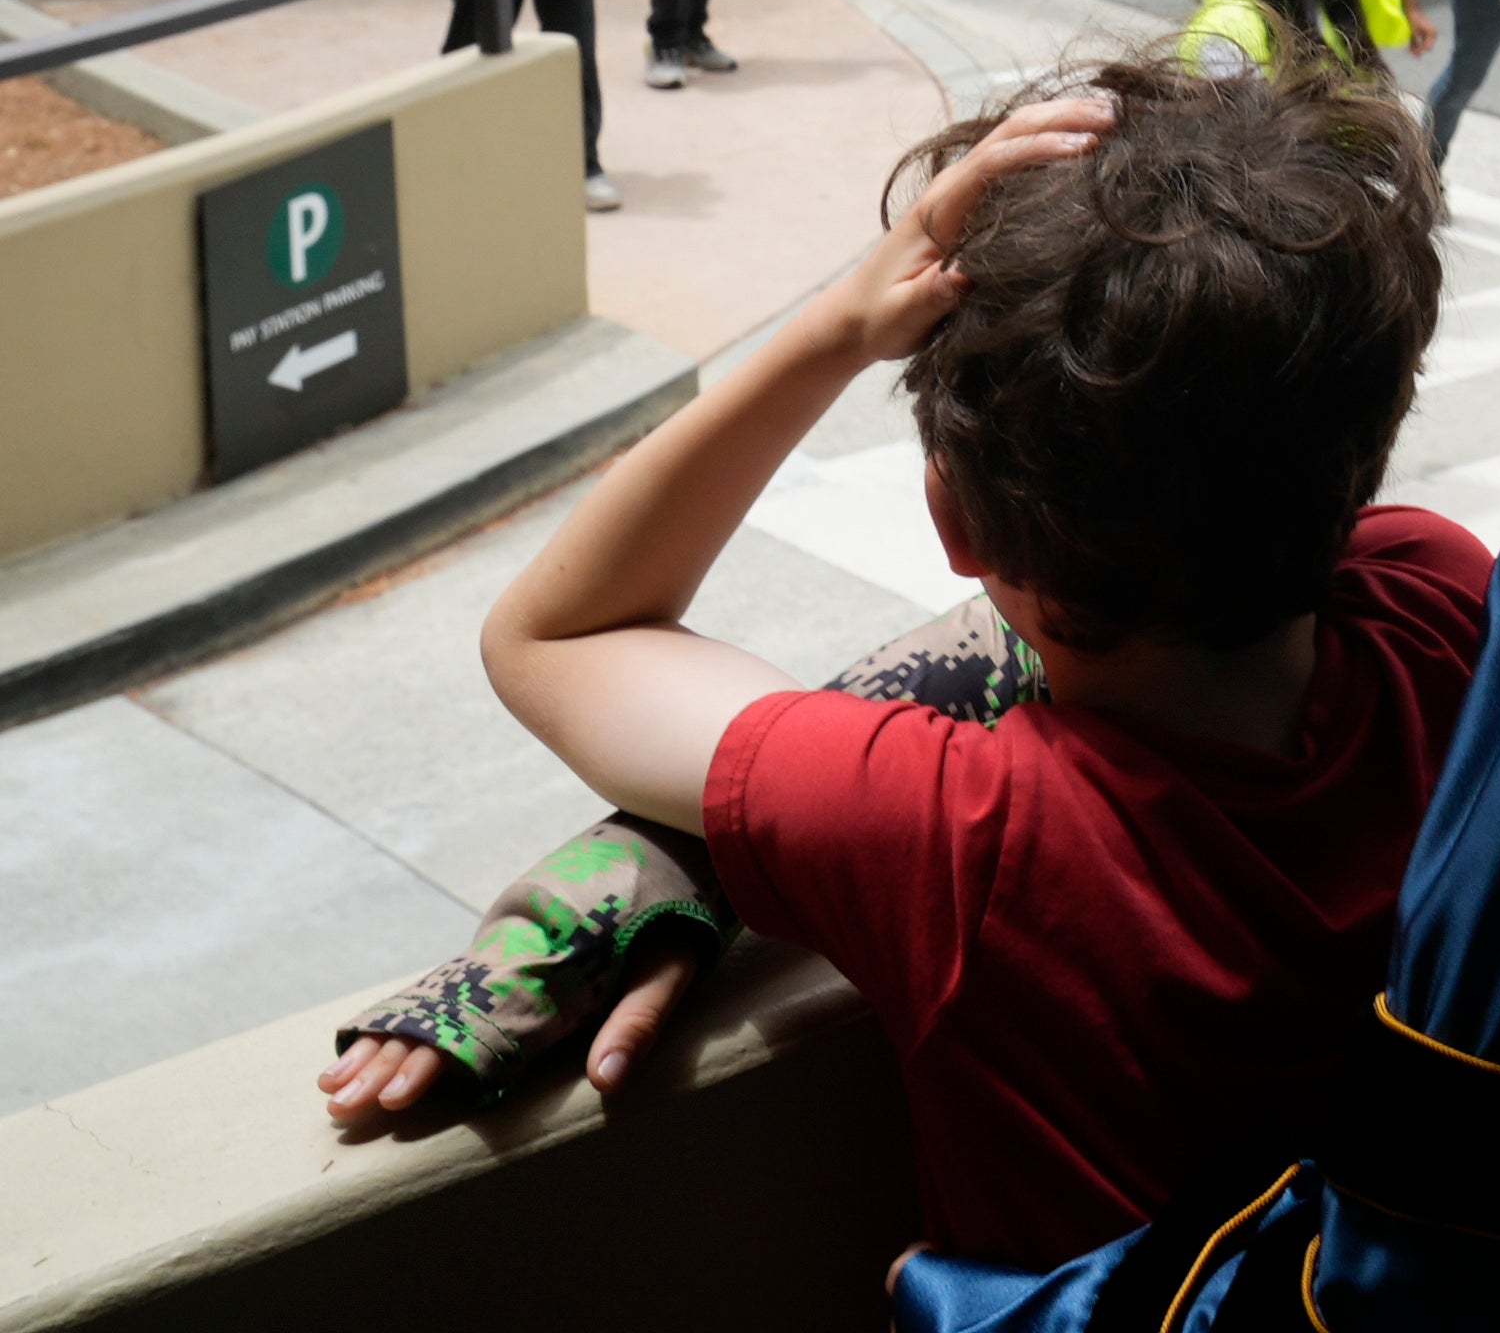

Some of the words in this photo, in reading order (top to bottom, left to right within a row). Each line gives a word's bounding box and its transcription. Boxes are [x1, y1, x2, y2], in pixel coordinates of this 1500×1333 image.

[287, 191, 329, 283] P
[229, 325, 258, 354] PAY
[258, 298, 324, 341] STATION
[322, 269, 387, 313] PARKING
